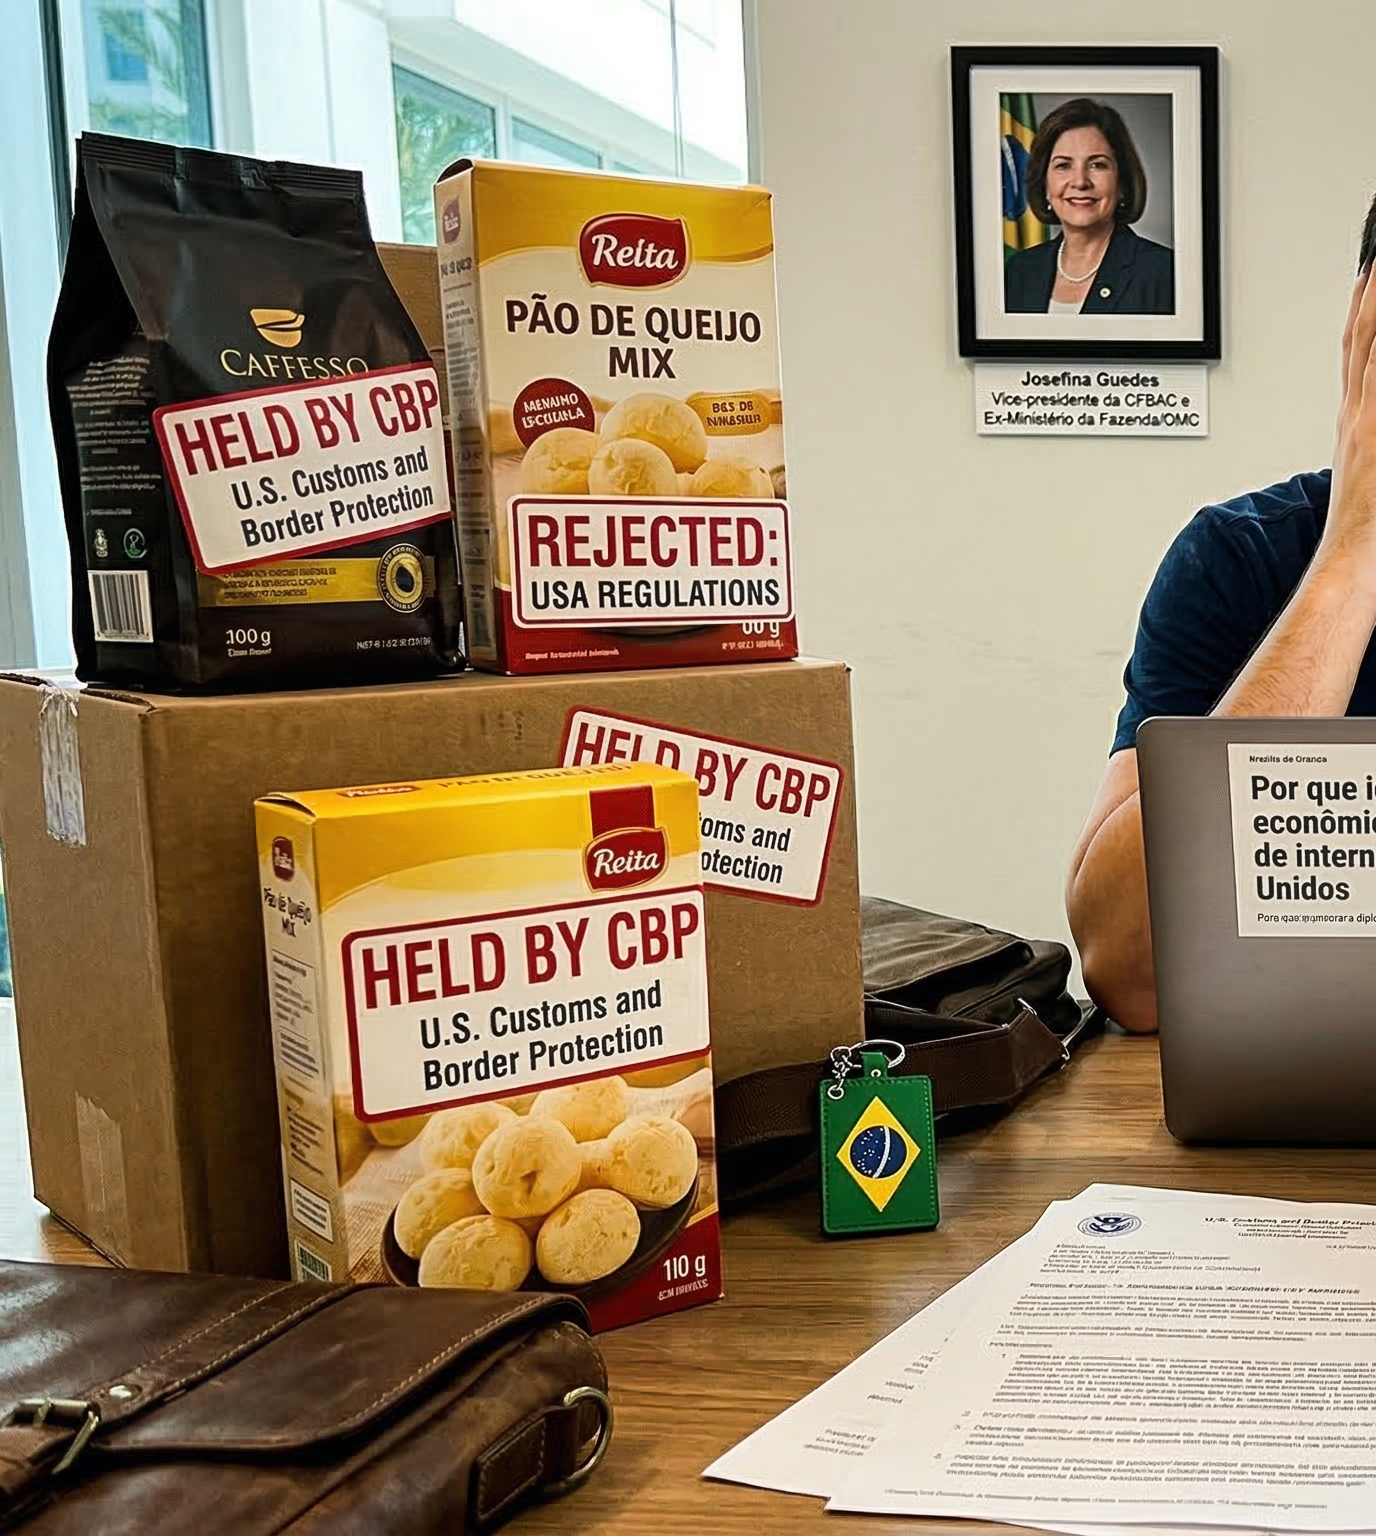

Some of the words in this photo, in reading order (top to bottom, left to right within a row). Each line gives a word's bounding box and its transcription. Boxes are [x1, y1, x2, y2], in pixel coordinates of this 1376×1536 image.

[505, 293, 580, 335] PÃO
[590, 304, 636, 336] DE
[645, 307, 762, 344] QUEIJO
[220, 349, 369, 380] CAFFESSO
[608, 346, 677, 379] MIX
[1021, 371, 1091, 387] Josefina
[1096, 371, 1160, 387] Guedes
[991, 392, 1099, 409] Vice-presidente
[1103, 393, 1121, 407] da
[1125, 393, 1177, 407] CFBAC
[1181, 396, 1190, 407] e
[174, 404, 301, 476] HELD
[304, 393, 361, 449] BY
[369, 379, 439, 437] CBP
[1078, 412, 1095, 426] da
[1100, 412, 1200, 427] Fazenda/OMC
[231, 476, 287, 510] U.S.
[292, 459, 389, 498] Customs
[394, 445, 429, 476] and
[240, 509, 325, 547] Border
[329, 485, 434, 527] Protection
[528, 514, 778, 568] REJECTED:
[531, 580, 590, 610] USA
[598, 578, 780, 609] REGULATIONS
[261, 631, 271, 646] g
[694, 749, 749, 801] BY
[755, 762, 831, 818] CBP
[1251, 775, 1299, 800] Por
[1306, 781, 1358, 806] que
[751, 828, 791, 851] and
[1254, 842, 1288, 868] de
[593, 848, 660, 878] Reita
[701, 850, 783, 883] otection
[1256, 875, 1350, 901] Unidos
[362, 931, 506, 1009] HELD
[525, 917, 589, 984] BY
[608, 902, 699, 970] CBP
[420, 1012, 480, 1049] U.S.
[490, 992, 607, 1037] Customs
[616, 979, 662, 1015] and
[423, 1050, 520, 1091] Border
[529, 1024, 664, 1071] Protection
[695, 1254, 706, 1277] g
